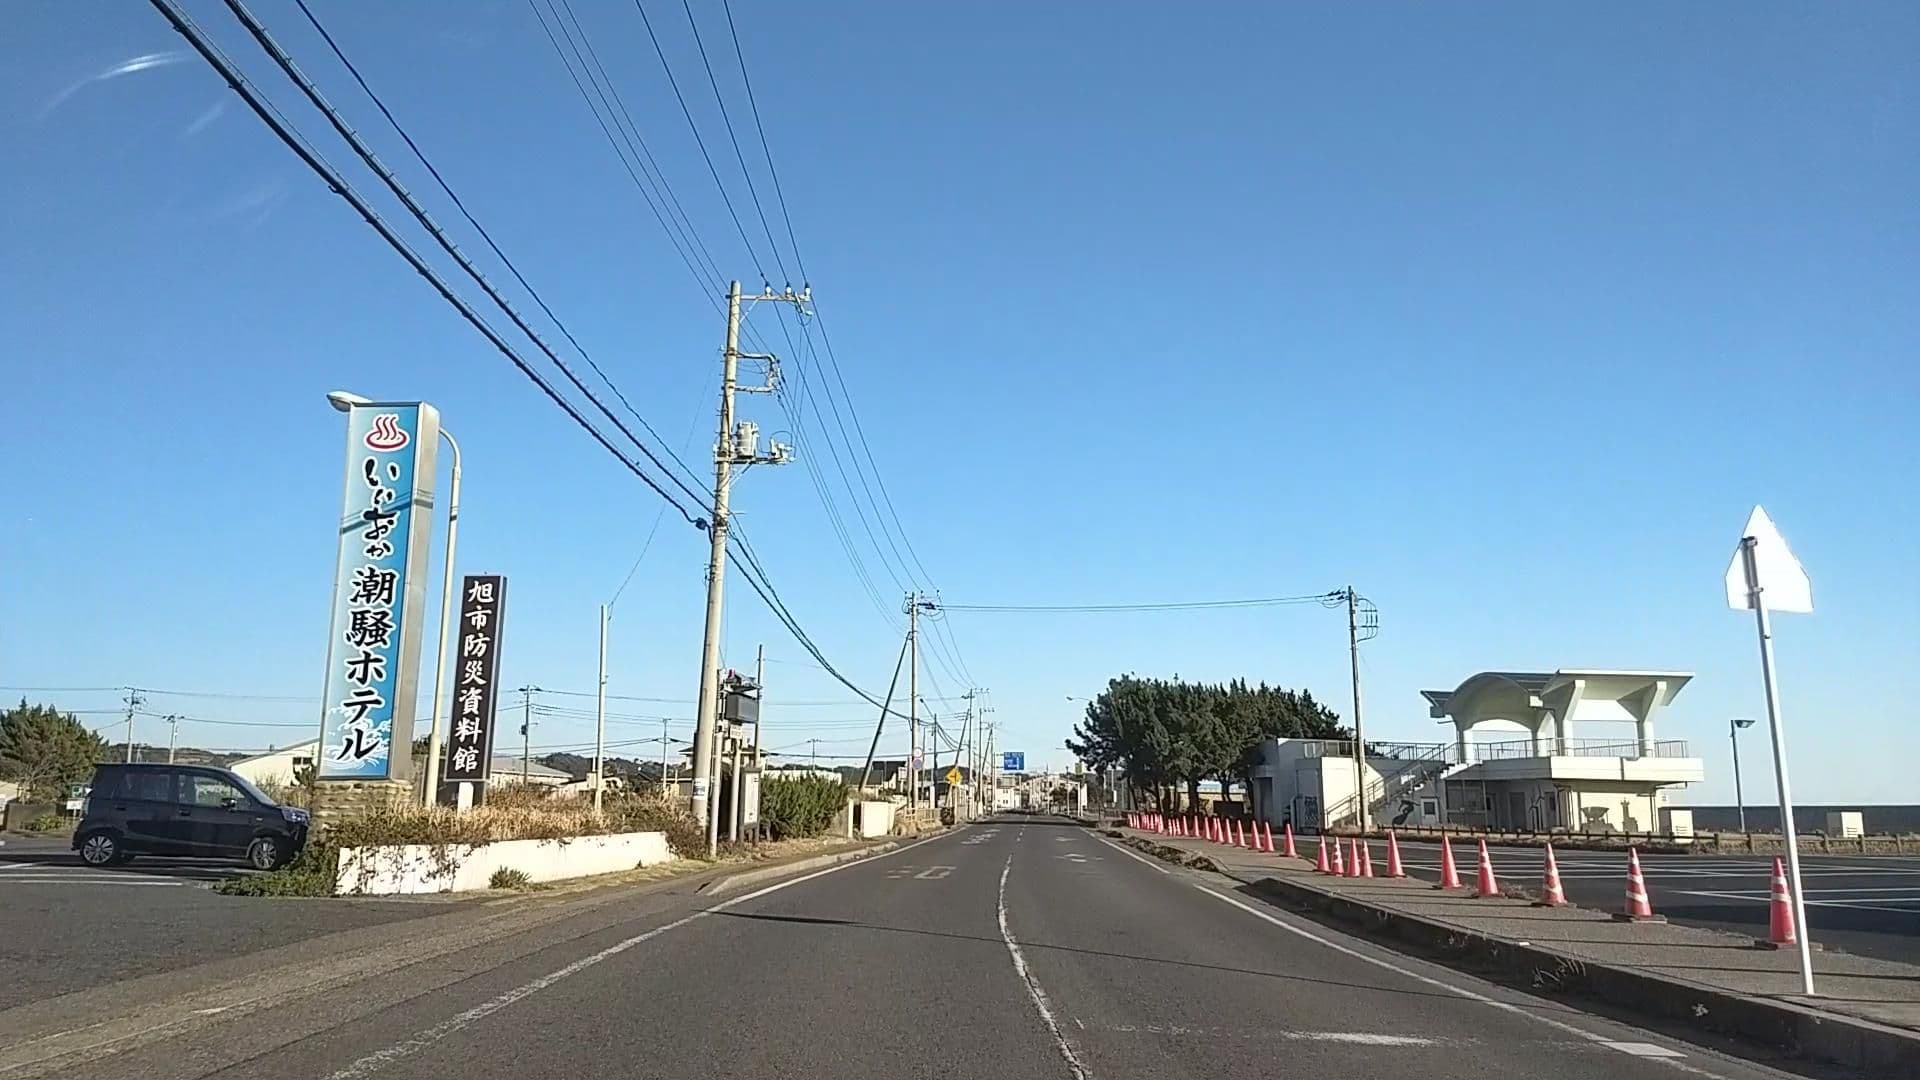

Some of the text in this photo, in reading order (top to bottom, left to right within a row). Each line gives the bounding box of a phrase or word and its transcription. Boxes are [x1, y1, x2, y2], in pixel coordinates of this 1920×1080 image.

[452, 580, 495, 773] 旭市防災資料館
